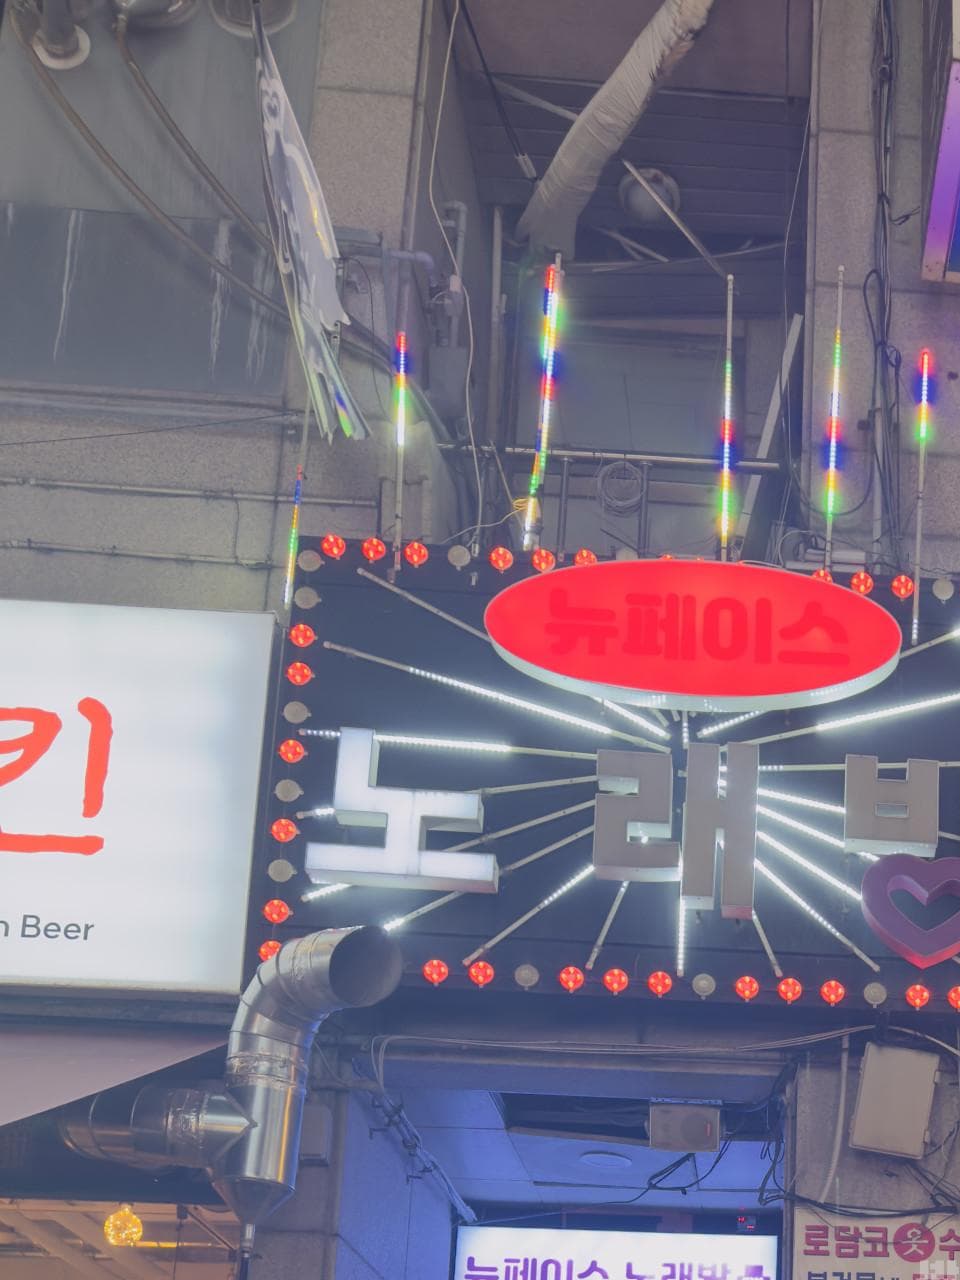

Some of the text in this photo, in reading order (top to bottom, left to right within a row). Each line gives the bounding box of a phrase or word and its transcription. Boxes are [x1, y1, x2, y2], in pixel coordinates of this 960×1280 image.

[545, 588, 851, 666] 뉴페이스
[21, 914, 94, 940] Beer
[803, 1224, 890, 1259] 로담코
[902, 1228, 929, 1256] 옷
